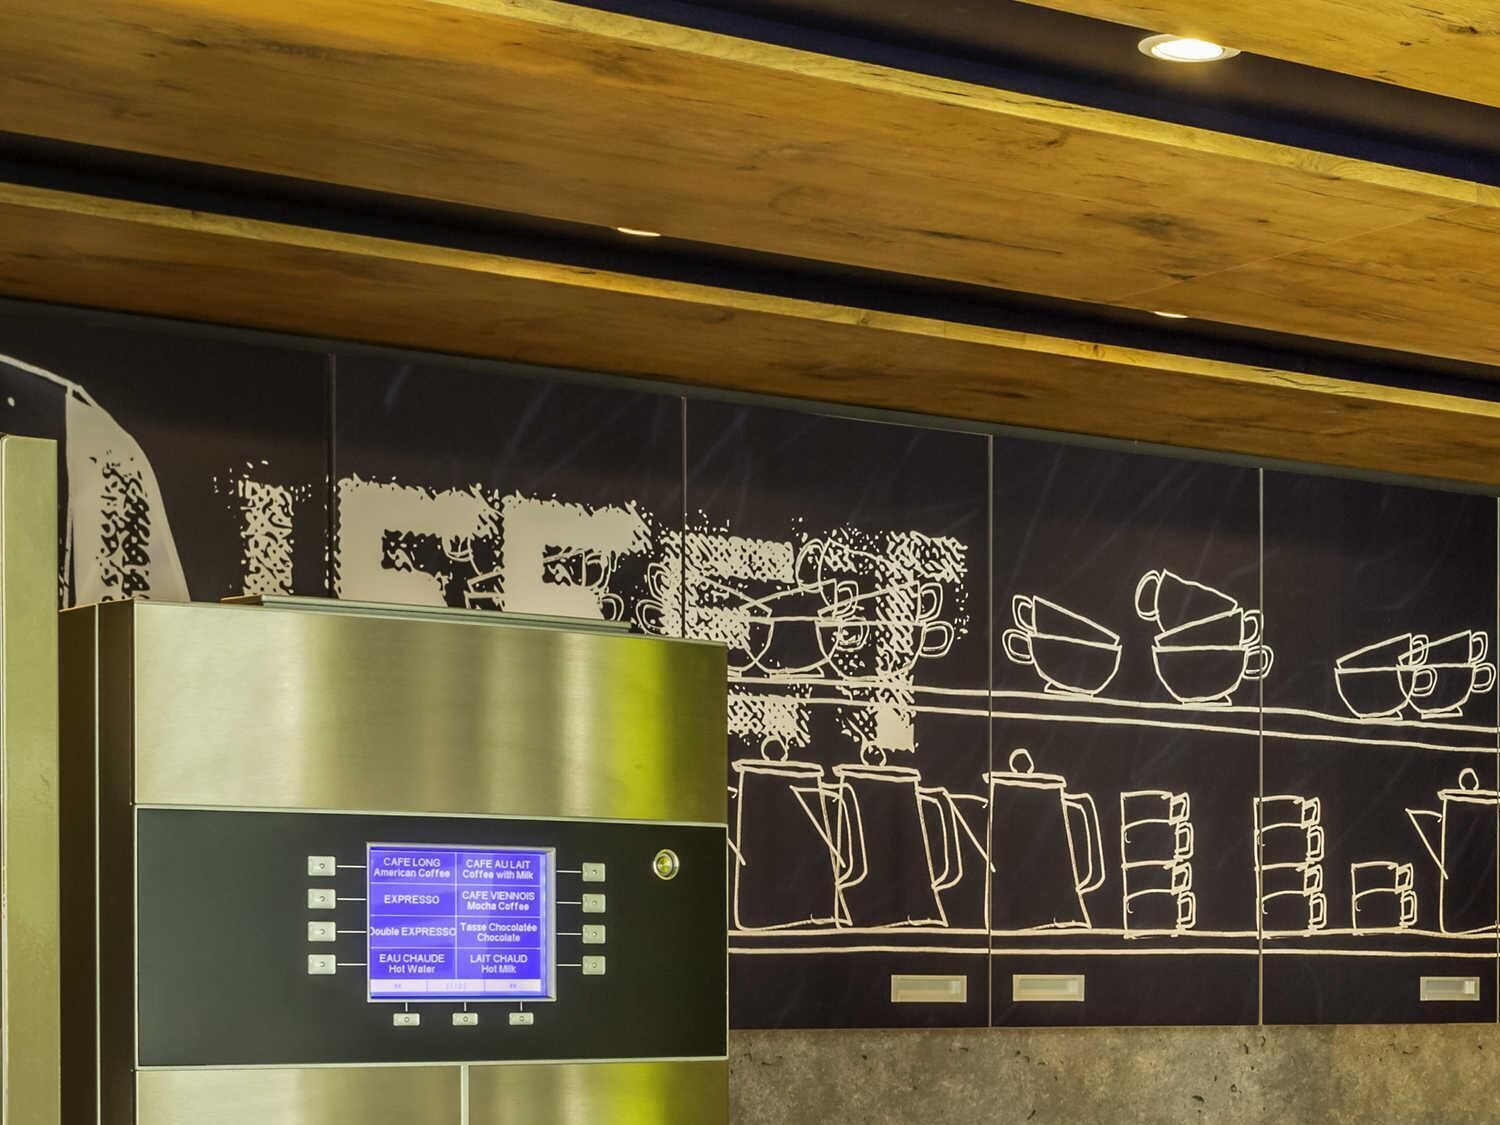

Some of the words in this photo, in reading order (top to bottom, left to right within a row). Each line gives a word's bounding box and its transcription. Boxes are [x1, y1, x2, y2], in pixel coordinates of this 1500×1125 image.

[383, 857, 411, 867] CAFE
[412, 858, 441, 867] LONG
[465, 859, 493, 868] CAFE
[495, 859, 509, 869] AU
[510, 860, 531, 869] LAIT
[373, 868, 417, 878] American
[418, 868, 451, 878] Coffee
[462, 869, 494, 879] Coffee
[496, 870, 515, 880] with
[516, 870, 534, 880] Milk
[383, 895, 440, 905] EXPRESSO
[462, 890, 489, 900] CAFE
[490, 891, 536, 901] VIENNOIS
[466, 901, 497, 911] Mocha
[498, 902, 530, 911] Coffee
[401, 927, 457, 937] EXPRESSO
[460, 922, 487, 932] Tasse
[477, 933, 521, 942] Chocolate
[379, 953, 402, 963] EAU
[402, 953, 446, 963] CHAUDE
[470, 954, 492, 963] LAIT
[493, 954, 528, 963] CHAUD
[388, 965, 405, 974] Hot
[407, 965, 436, 974] Water
[481, 965, 497, 974] Hot
[499, 965, 517, 974] Milk
